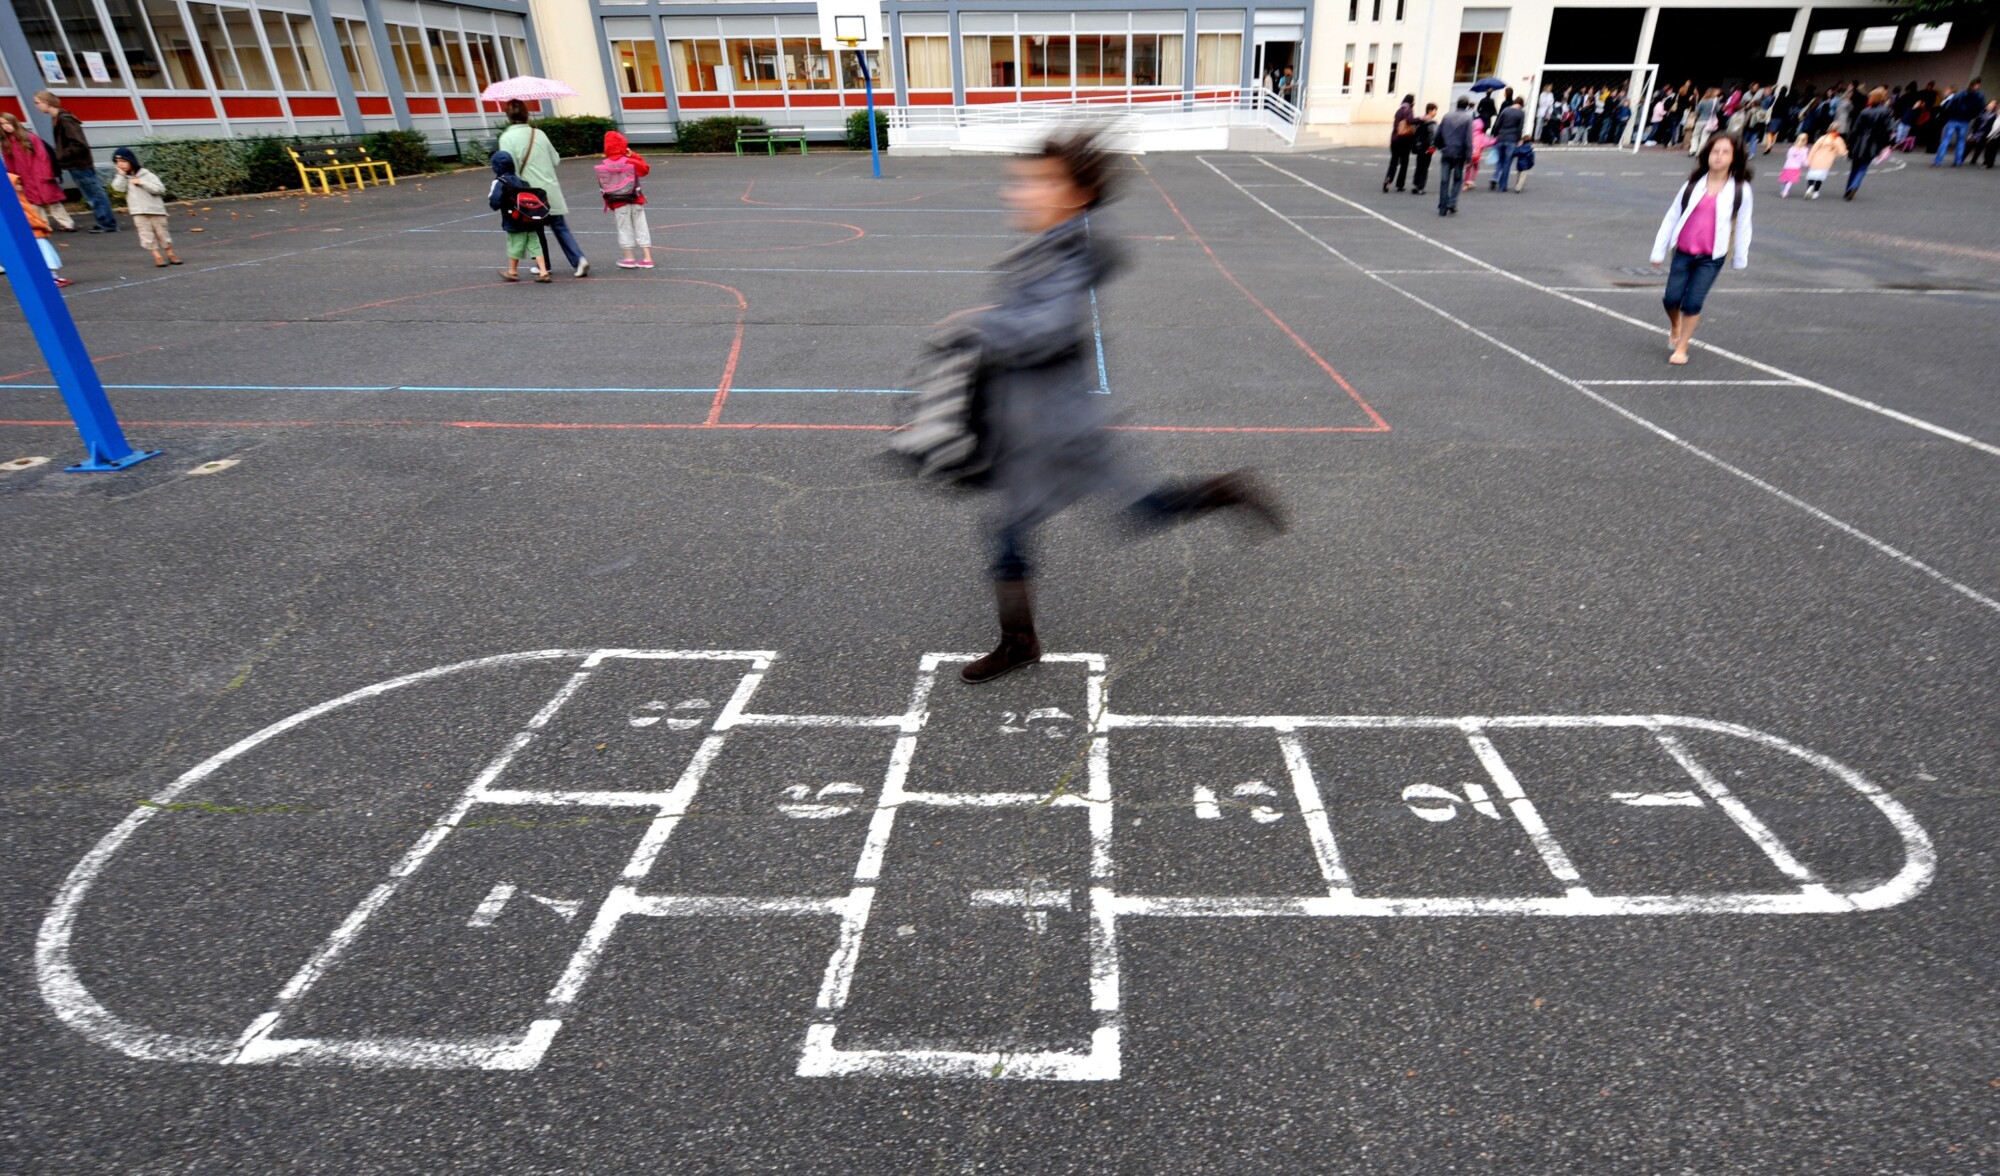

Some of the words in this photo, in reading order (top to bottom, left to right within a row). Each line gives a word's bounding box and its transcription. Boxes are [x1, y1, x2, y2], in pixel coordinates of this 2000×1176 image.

[629, 699, 711, 730] 8
[1000, 707, 1074, 739] 5
[776, 782, 865, 819] 6
[1194, 781, 1284, 824] 3
[1402, 783, 1501, 822] 2
[1610, 791, 1705, 807] 1
[466, 884, 584, 925] 7
[970, 878, 1072, 934] 4
